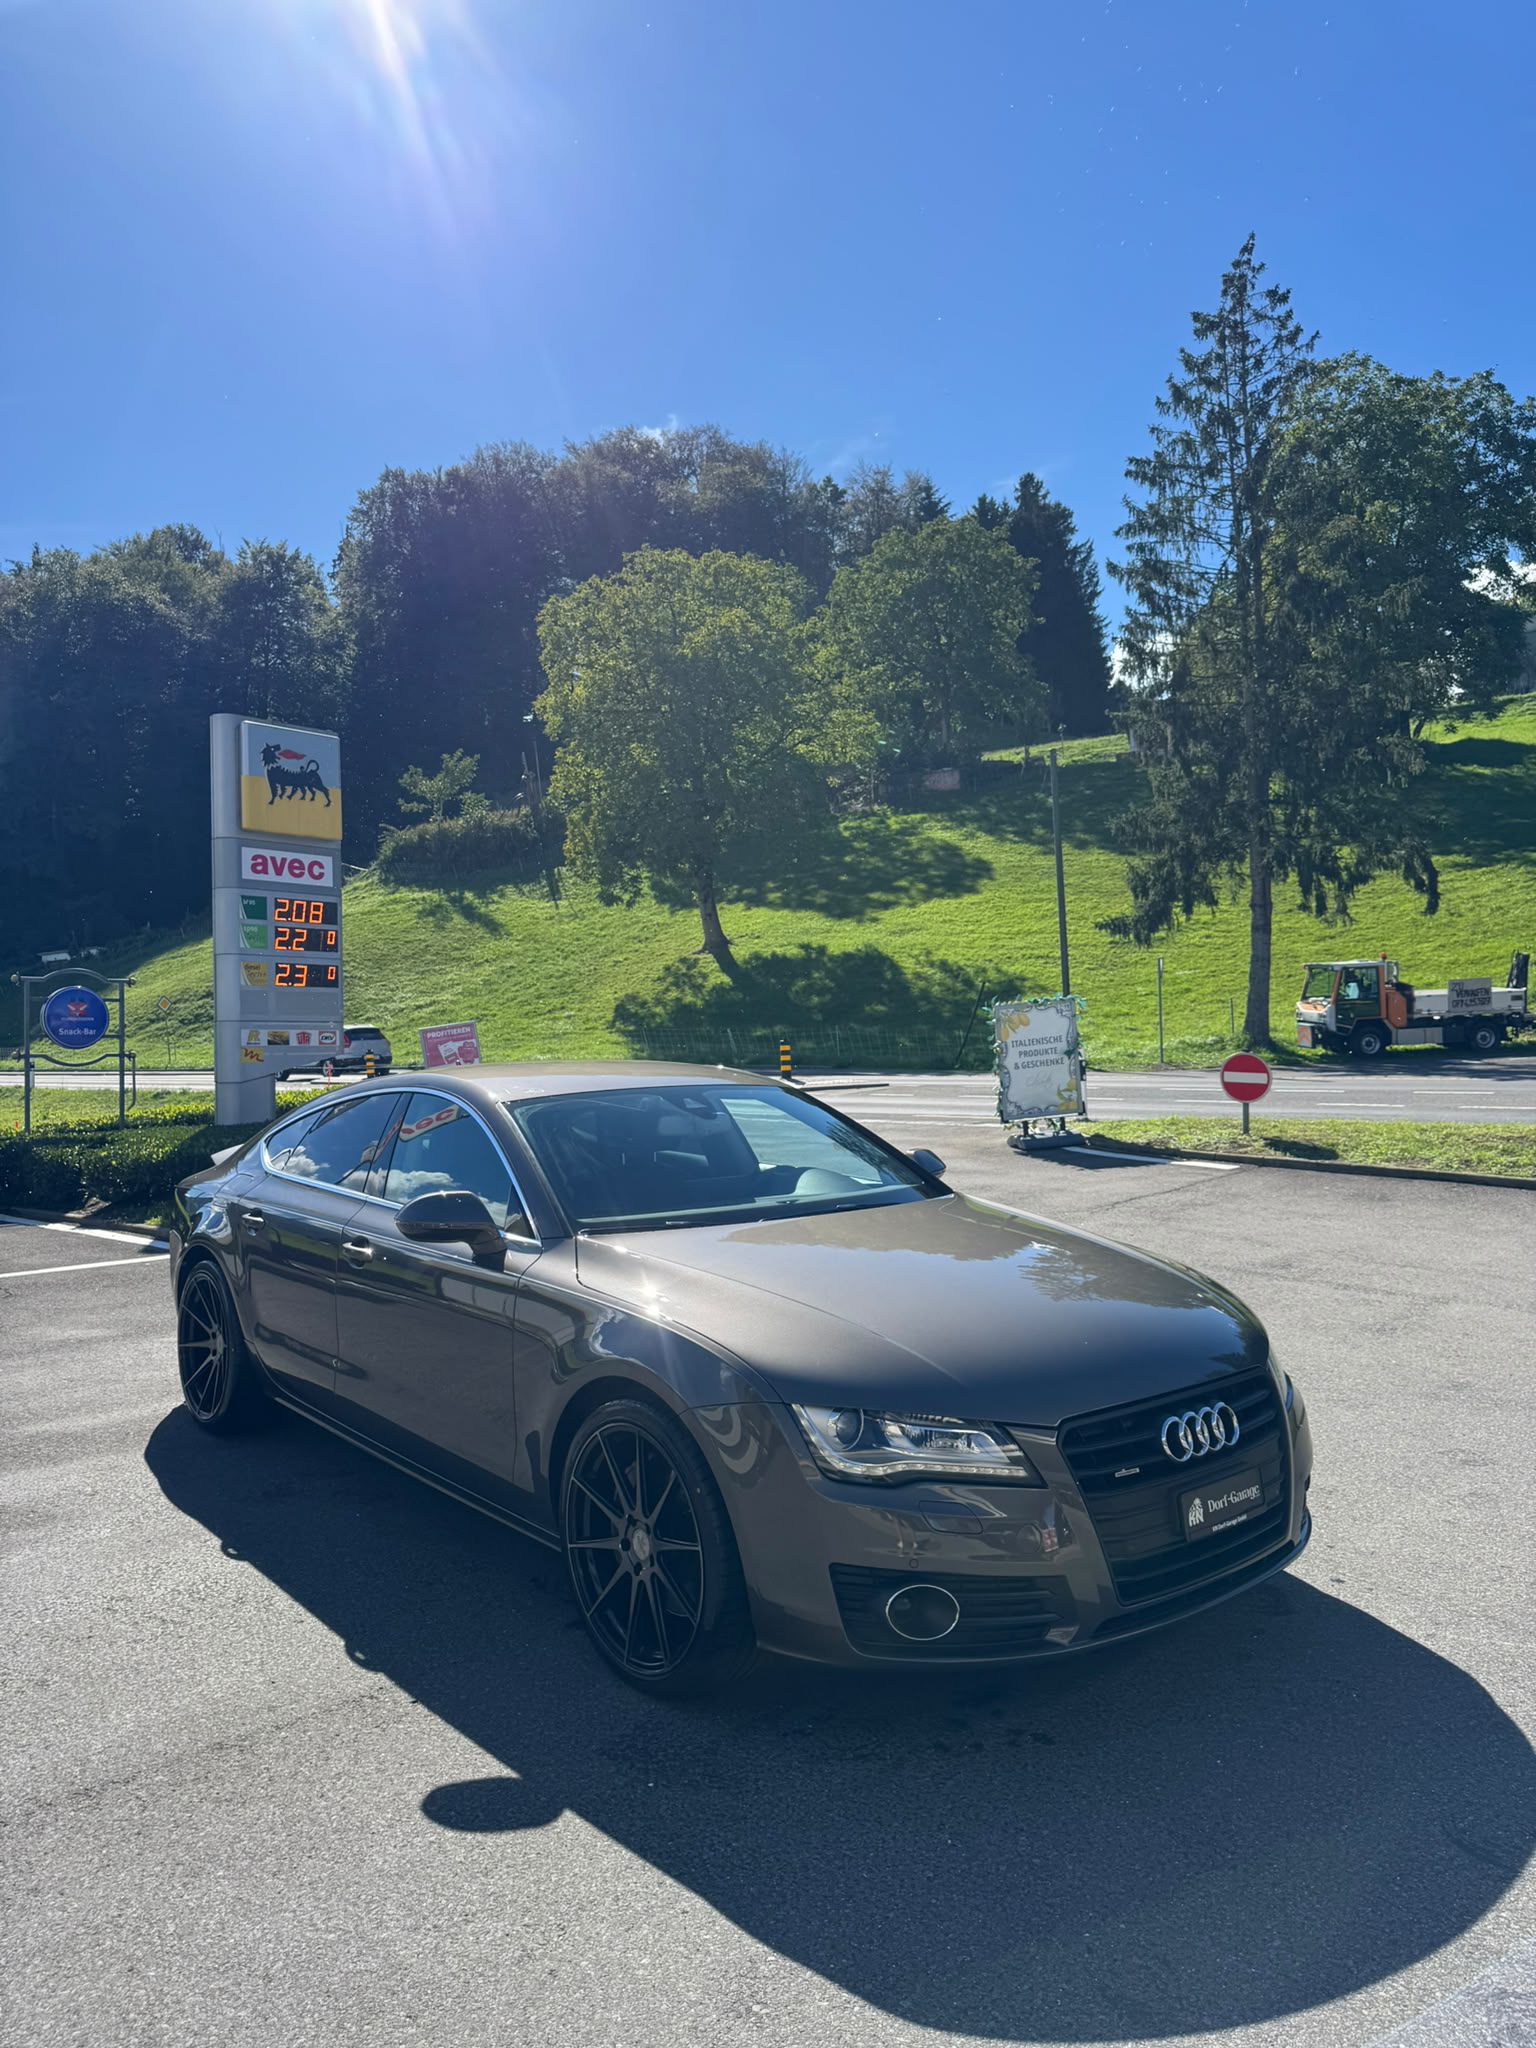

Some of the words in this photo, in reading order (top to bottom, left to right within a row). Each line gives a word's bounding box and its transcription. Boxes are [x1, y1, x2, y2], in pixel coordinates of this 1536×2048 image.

[250, 854, 325, 880] avec
[274, 899, 323, 924] 2.08
[58, 1027, 97, 1036] Snack-Bar
[1011, 1035, 1063, 1048] ITALIENISCHE
[1018, 1047, 1058, 1058] PRODUKTE
[1014, 1062, 1020, 1070] &
[1021, 1057, 1064, 1070] GESCHENKE
[1207, 1485, 1260, 1513] Dorf-Garage
